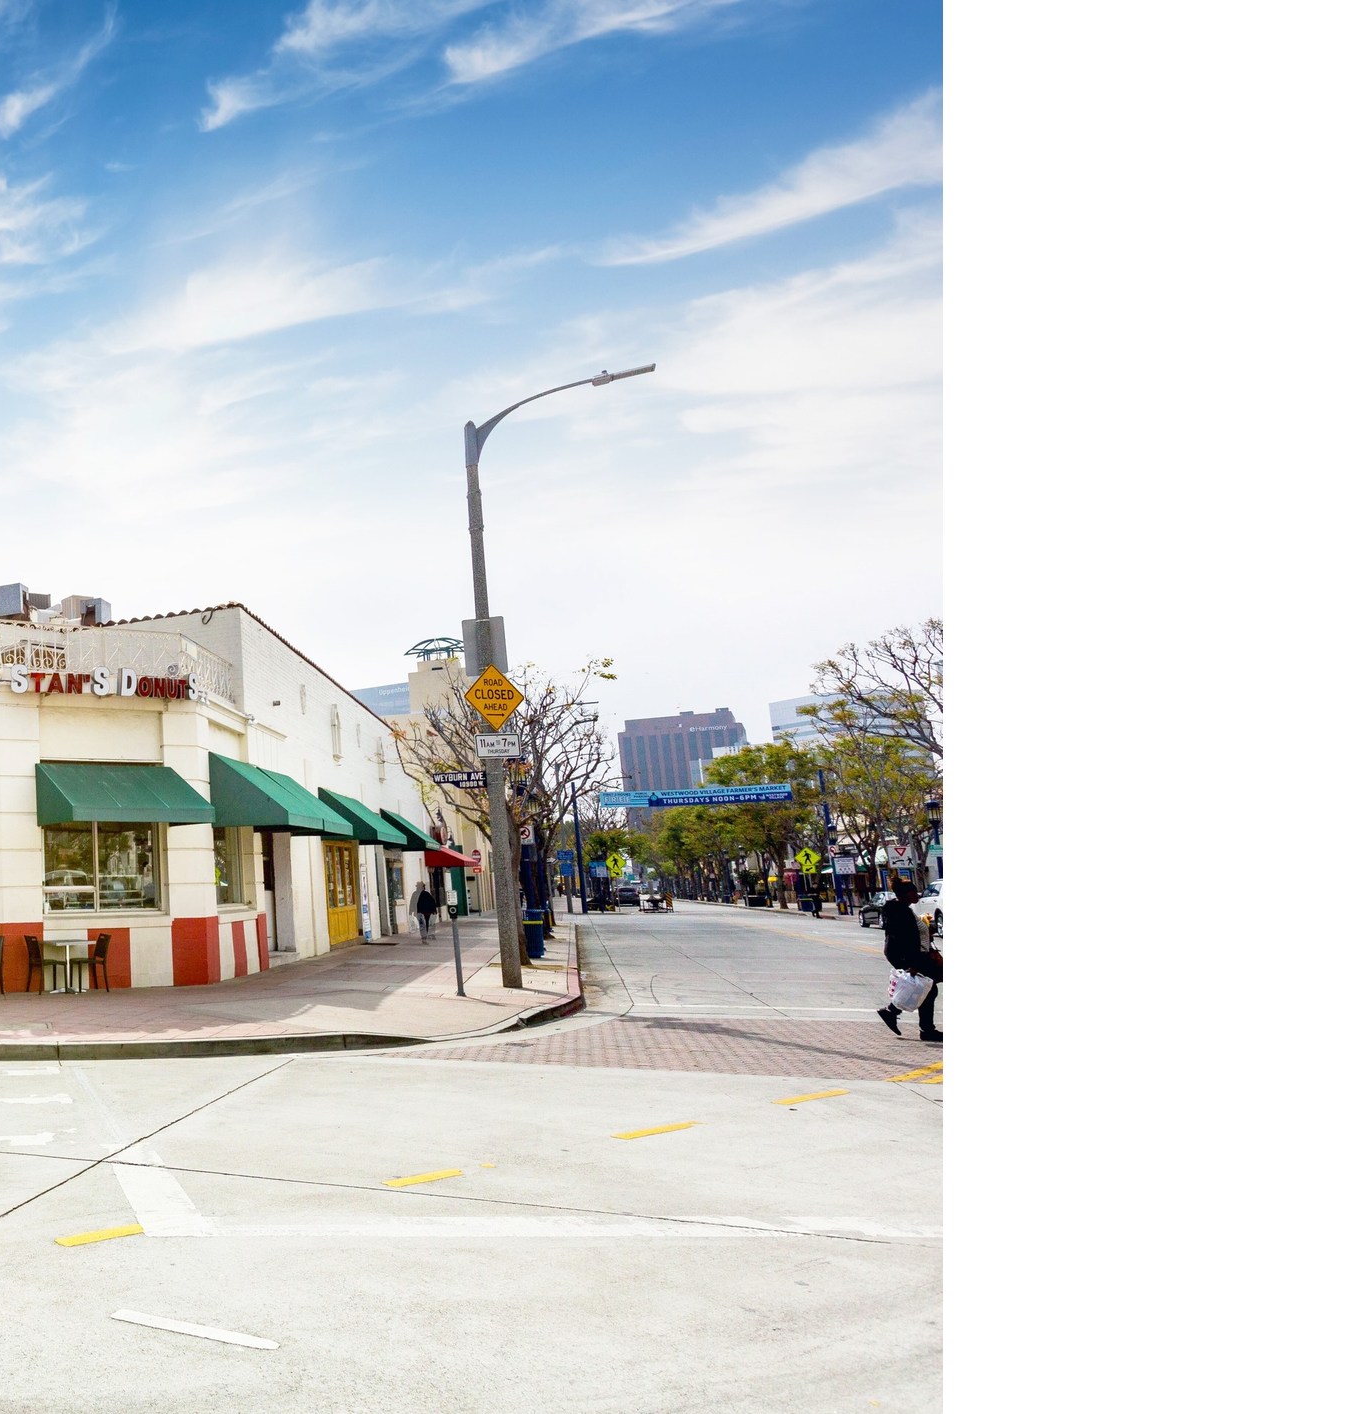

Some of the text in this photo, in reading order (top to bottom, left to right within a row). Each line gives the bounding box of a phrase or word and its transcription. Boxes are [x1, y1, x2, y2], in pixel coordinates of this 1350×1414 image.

[10, 664, 199, 700] STAN'S DONUTS
[483, 678, 504, 687] ROAD
[474, 688, 515, 700] CLOSED
[483, 703, 508, 711] AHEAD
[689, 725, 728, 733] eHarmony
[433, 772, 486, 782] WEYBURN AVE.
[662, 794, 757, 804] THURSDAYS NOON-6PM
